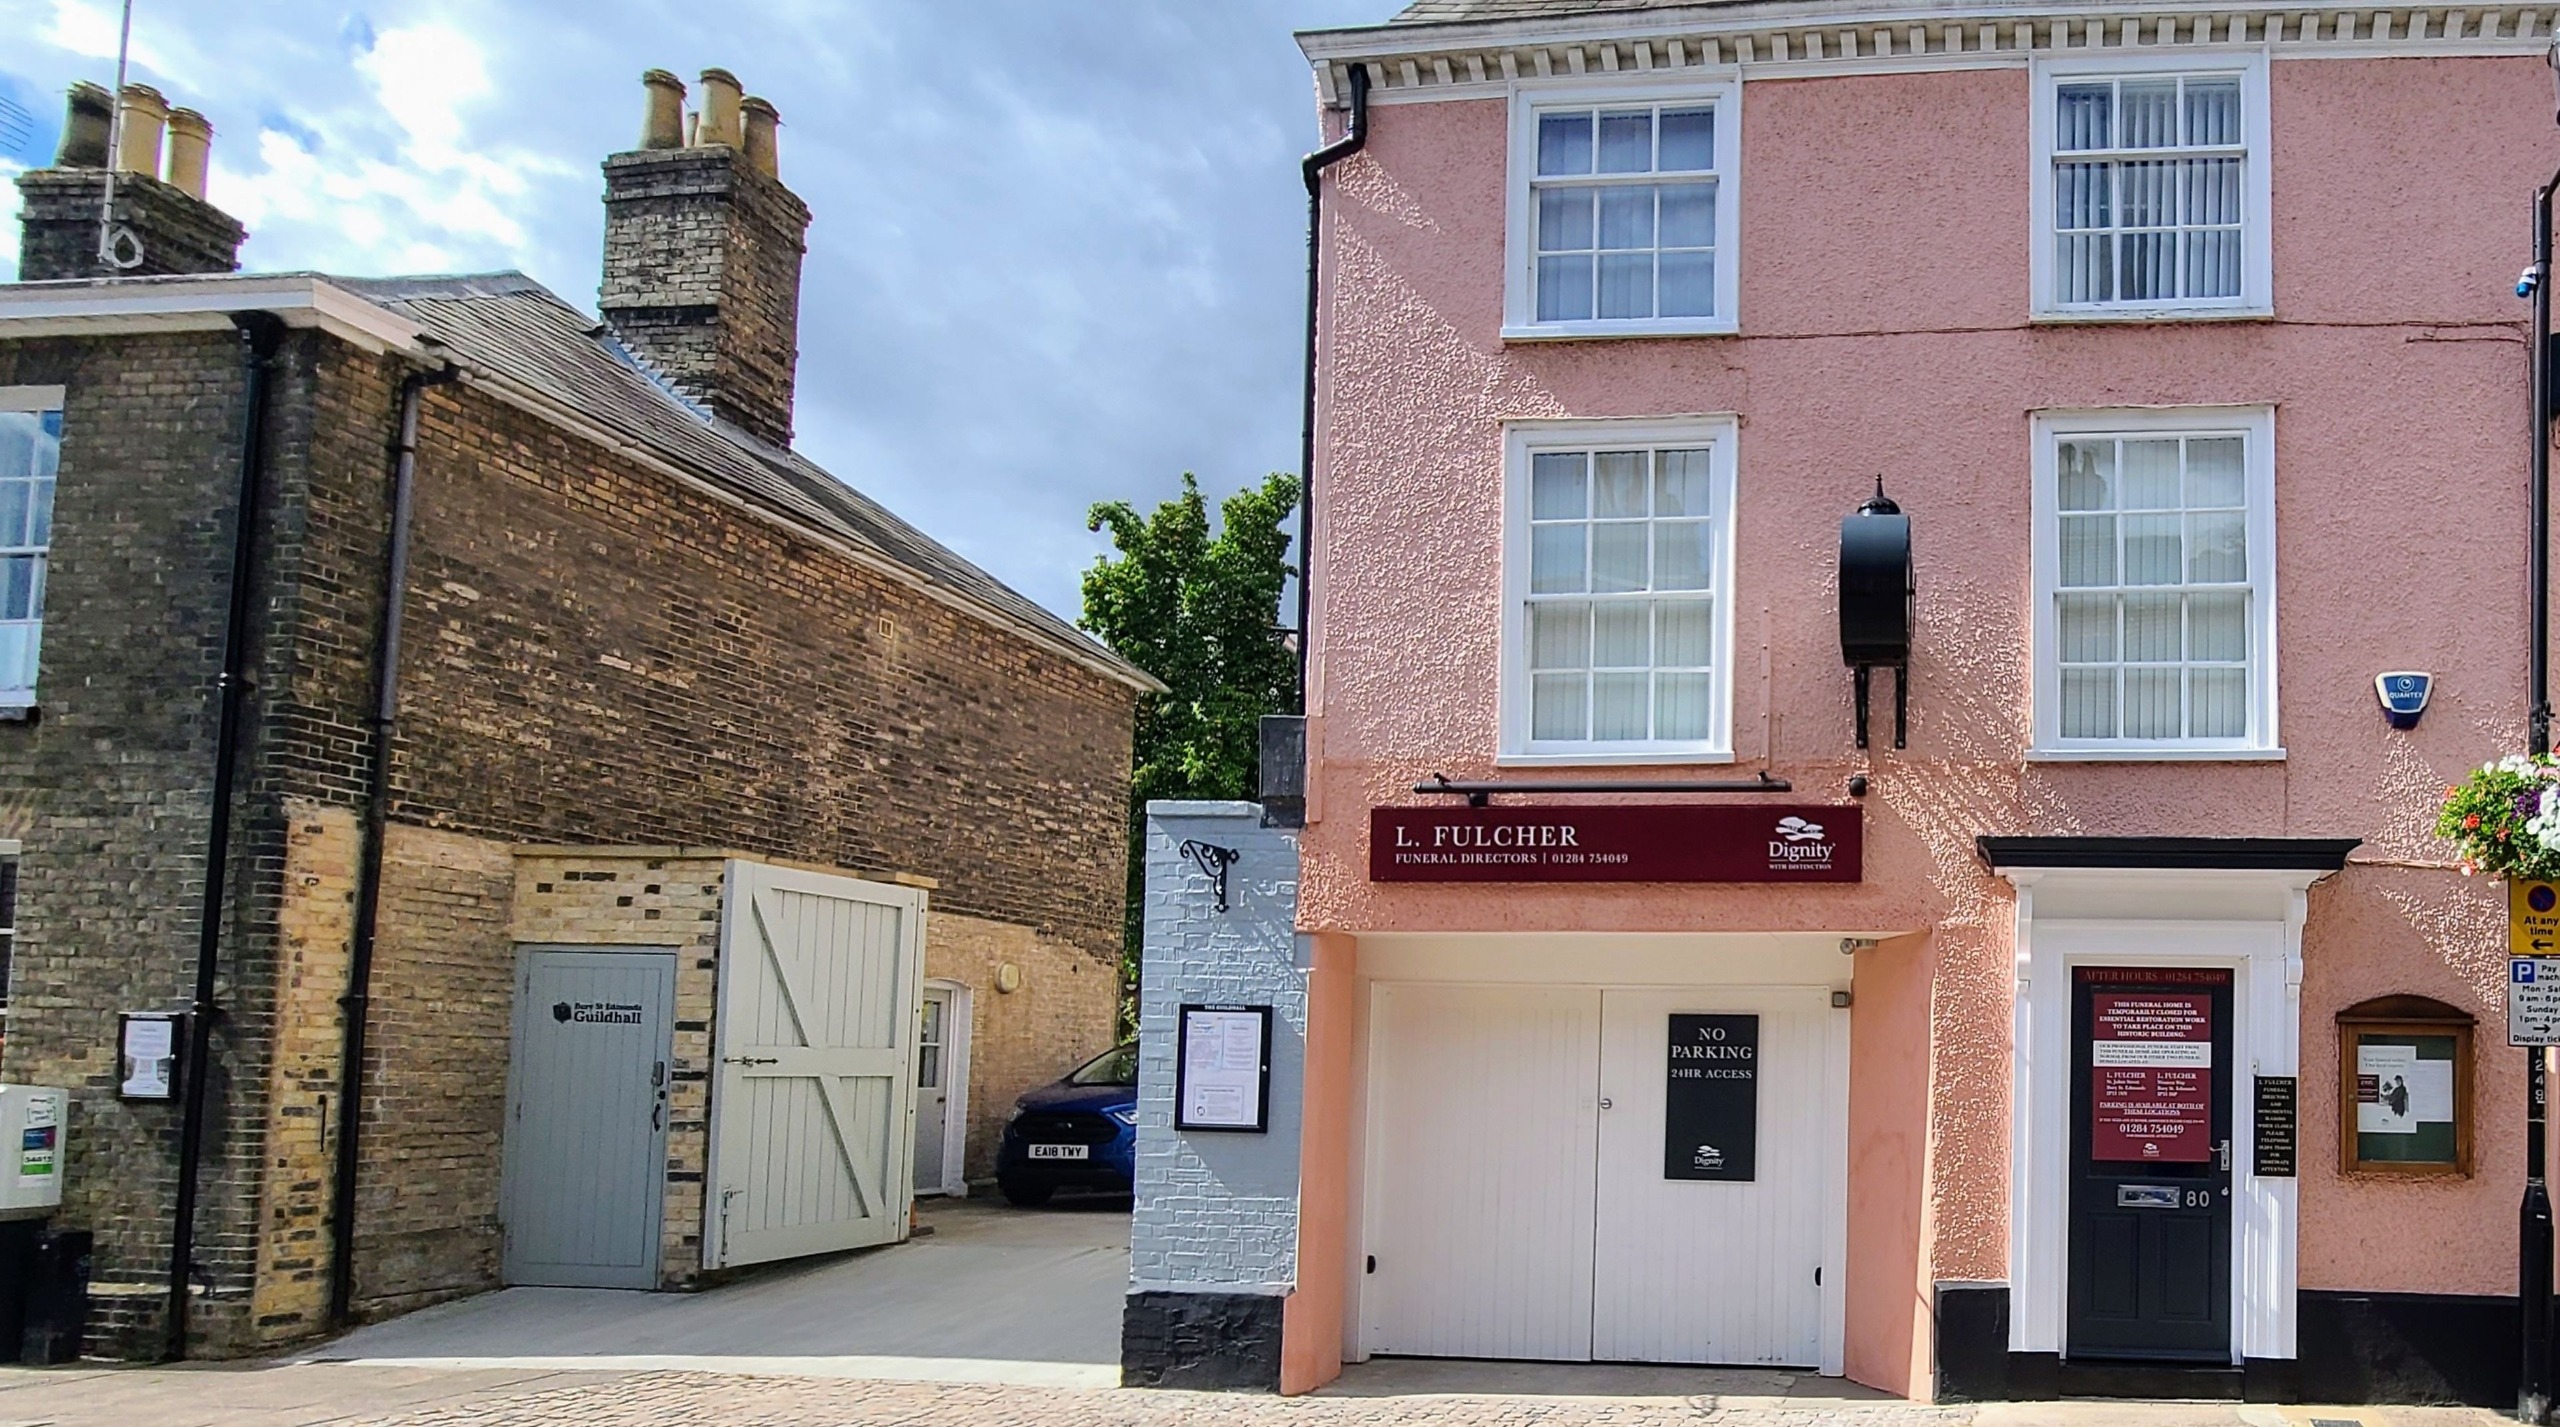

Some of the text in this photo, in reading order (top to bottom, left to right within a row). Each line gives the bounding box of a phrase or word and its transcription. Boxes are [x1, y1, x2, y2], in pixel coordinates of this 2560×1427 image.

[2389, 691, 2423, 699] QUANTEX
[1395, 826, 1579, 847] L. FULCHER
[1768, 841, 1834, 862] Dignity
[1395, 853, 1457, 864] FUNERAL
[1461, 853, 1537, 864] DIRECTORS
[1552, 853, 1584, 864] 01284
[1589, 853, 1628, 864] 754049
[2524, 915, 2559, 927] At any
[2530, 926, 2554, 936] time
[2517, 963, 2532, 982] P
[2541, 964, 2557, 973] Pay
[2085, 970, 2118, 981] AFTER
[2121, 971, 2158, 981] HOURS
[2165, 972, 2191, 982] 01284
[2522, 985, 2541, 993] Mon
[2518, 994, 2524, 1002] 9
[574, 1002, 593, 1011] Bury
[595, 1002, 603, 1010] St
[2526, 1005, 2558, 1014] Sunday
[573, 1011, 642, 1024] Guildhall
[2184, 1016, 2206, 1024] WORK
[1698, 1027, 1726, 1041] NO
[2513, 1034, 2545, 1043] Display
[1671, 1045, 1752, 1060] PARKING
[1671, 1068, 1752, 1079] 24HR ACCESS
[2119, 1123, 2184, 1134] 01284 754049
[1034, 1146, 1058, 1157] EA18
[1694, 1156, 1725, 1167] Dignity
[2186, 1190, 2210, 1208] 80
